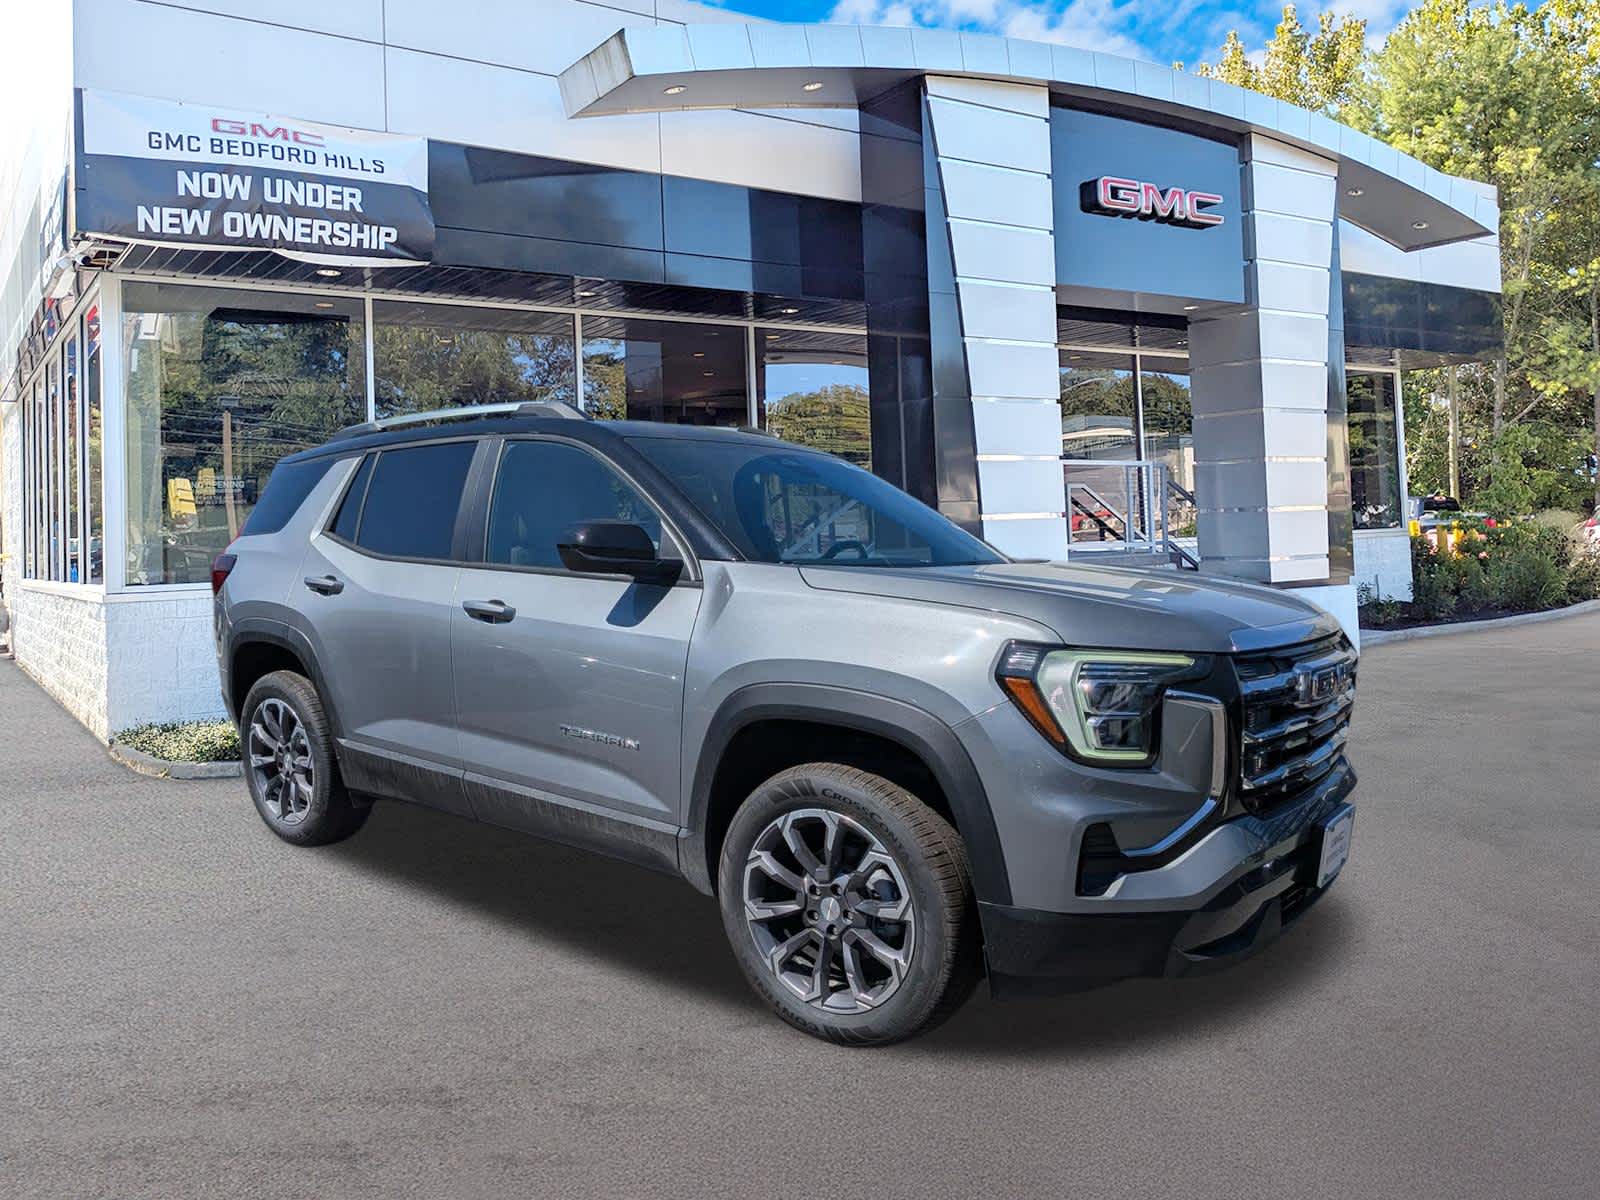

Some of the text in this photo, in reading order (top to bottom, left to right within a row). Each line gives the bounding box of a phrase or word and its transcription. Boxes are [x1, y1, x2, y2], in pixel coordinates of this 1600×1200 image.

[148, 131, 385, 174] GMC BEDFORD HILLS
[211, 117, 326, 148] GMC
[177, 170, 364, 213] NOW UNDER
[1097, 176, 1225, 225] GMC
[136, 205, 398, 250] NEW OWNERSHIP
